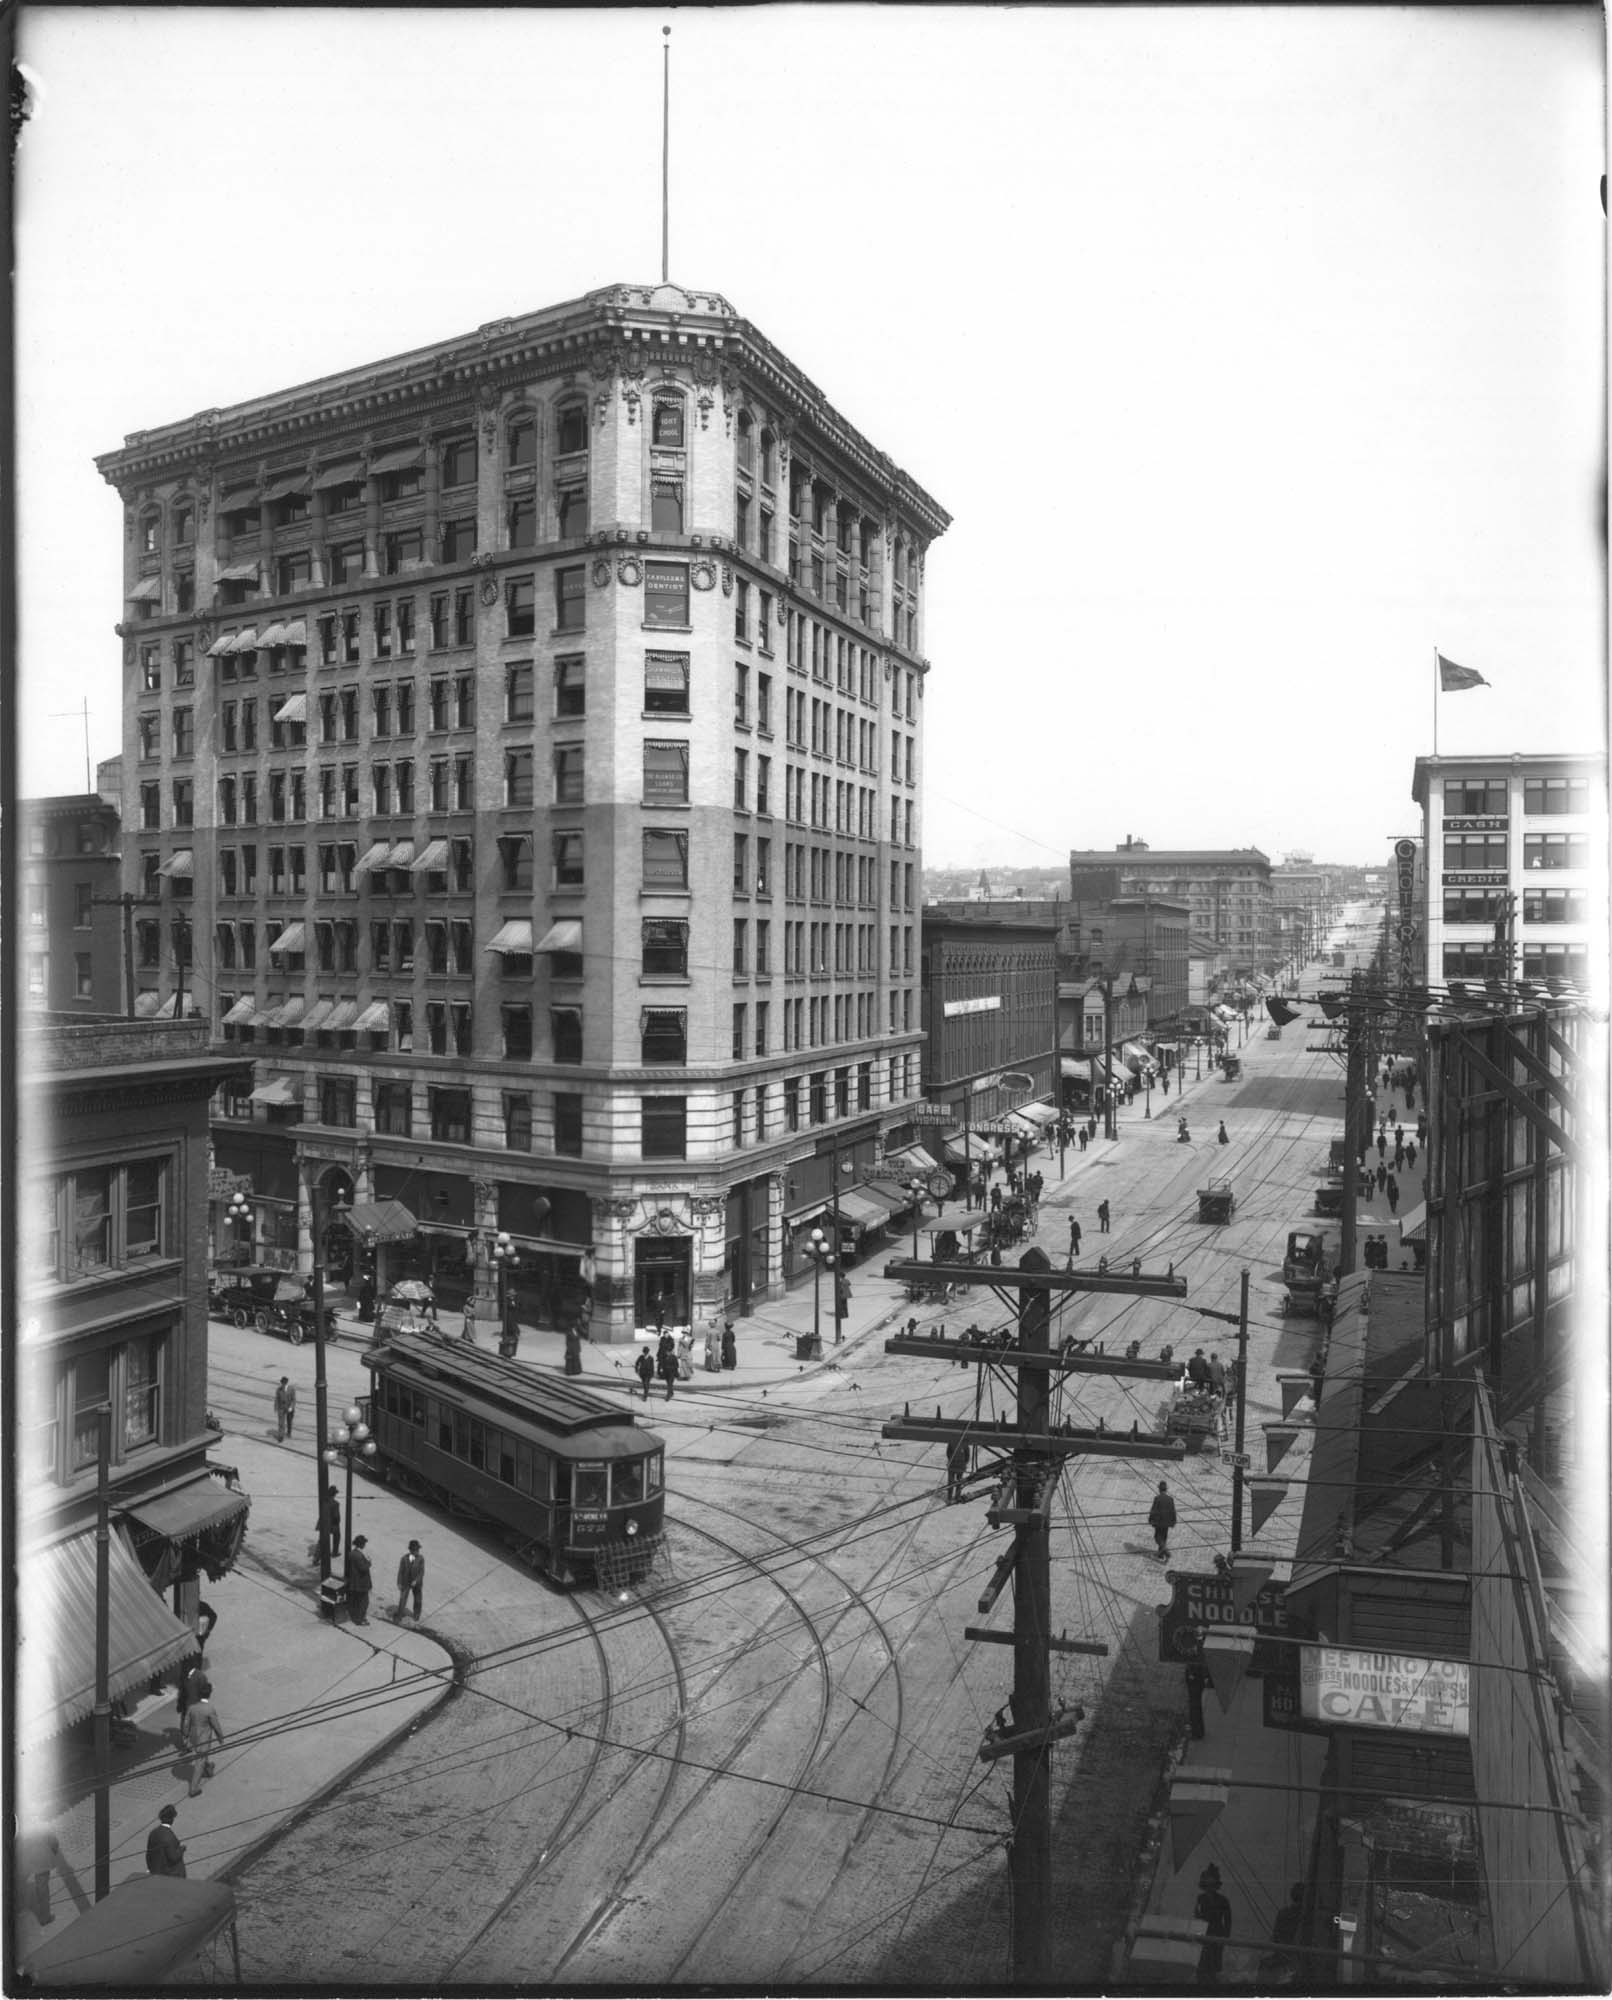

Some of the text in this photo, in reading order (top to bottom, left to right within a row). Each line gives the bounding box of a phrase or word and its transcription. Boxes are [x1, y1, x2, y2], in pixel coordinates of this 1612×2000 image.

[647, 583, 684, 591] DENTIST
[1450, 820, 1501, 829] CASH
[1448, 875, 1504, 884] CREDIT
[1224, 1453, 1249, 1465] STOP
[1188, 1584, 1287, 1606] CHISE
[1188, 1601, 1289, 1629] NOODLE
[1303, 1647, 1351, 1669] MEE
[1343, 1671, 1401, 1694] NOODLES
[1321, 1690, 1454, 1729] CAFE
